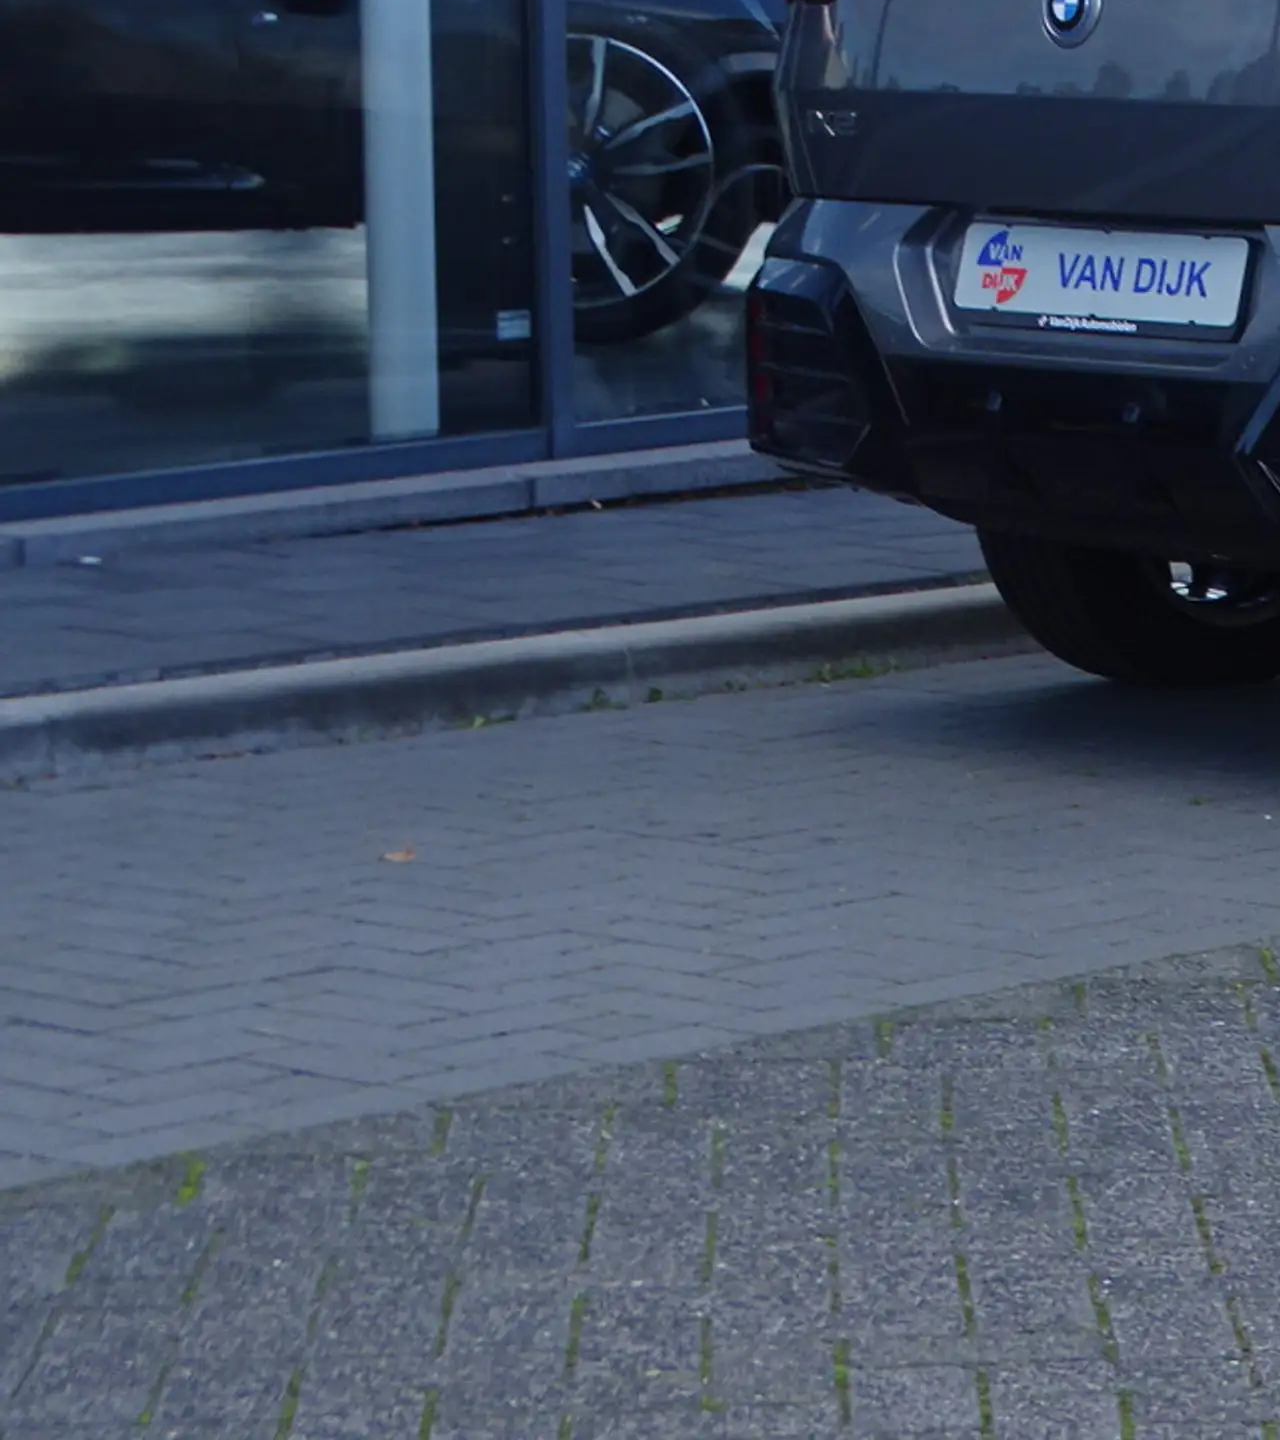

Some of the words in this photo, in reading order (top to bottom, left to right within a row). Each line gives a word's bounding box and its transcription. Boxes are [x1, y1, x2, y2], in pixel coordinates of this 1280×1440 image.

[987, 243, 1023, 262] VAN
[981, 272, 1019, 292] DIJK
[1058, 252, 1125, 292] VAN
[1132, 257, 1212, 298] DIJK
